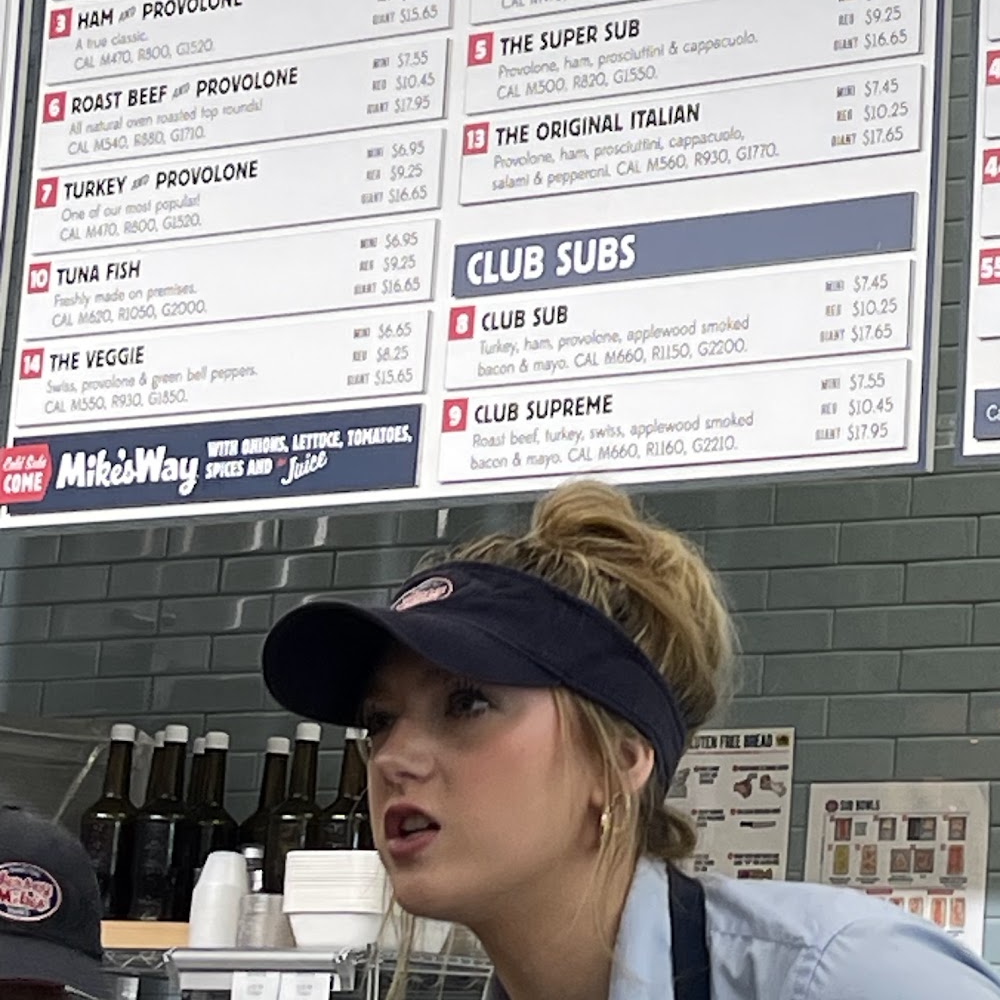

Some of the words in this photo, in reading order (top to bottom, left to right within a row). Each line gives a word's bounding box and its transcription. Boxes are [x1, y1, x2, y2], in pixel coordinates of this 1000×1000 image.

[55, 13, 66, 33] 3
[77, 8, 114, 30] HAM
[864, 4, 902, 26] $9.25
[474, 39, 487, 60] 5
[499, 33, 534, 56] THE
[539, 24, 598, 51] SUPER
[604, 18, 640, 42] SUB
[863, 28, 908, 50] $16.65
[48, 98, 60, 118] 6
[71, 90, 123, 114] ROAST
[127, 84, 168, 107] BEEF
[196, 66, 298, 98] PROVOLONE
[466, 128, 486, 150] 13
[495, 124, 530, 147] THE
[536, 113, 624, 141] ORIGINAL
[630, 102, 700, 130] ITALIAN
[41, 183, 53, 204] 7
[64, 175, 128, 200] TURKEY
[155, 159, 258, 190] PROVOLONE
[31, 268, 48, 289] 10
[56, 264, 100, 286] TUNA
[106, 259, 141, 281] FISH
[467, 244, 544, 284] CLUB
[556, 234, 636, 276] SUBS
[455, 313, 469, 335] 8
[481, 309, 526, 332] CLUB
[532, 305, 568, 328] SUB
[23, 354, 41, 375] 14
[49, 351, 80, 372] THE
[86, 345, 144, 369] VEGGIE
[849, 371, 886, 392] $7.55
[448, 405, 462, 427] 9
[474, 402, 519, 424] CLUB
[526, 394, 613, 421] SUPREME
[848, 396, 894, 417] $10.45
[847, 421, 889, 442] $17.95
[3, 472, 44, 493] COME
[204, 459, 243, 478] SPICES
